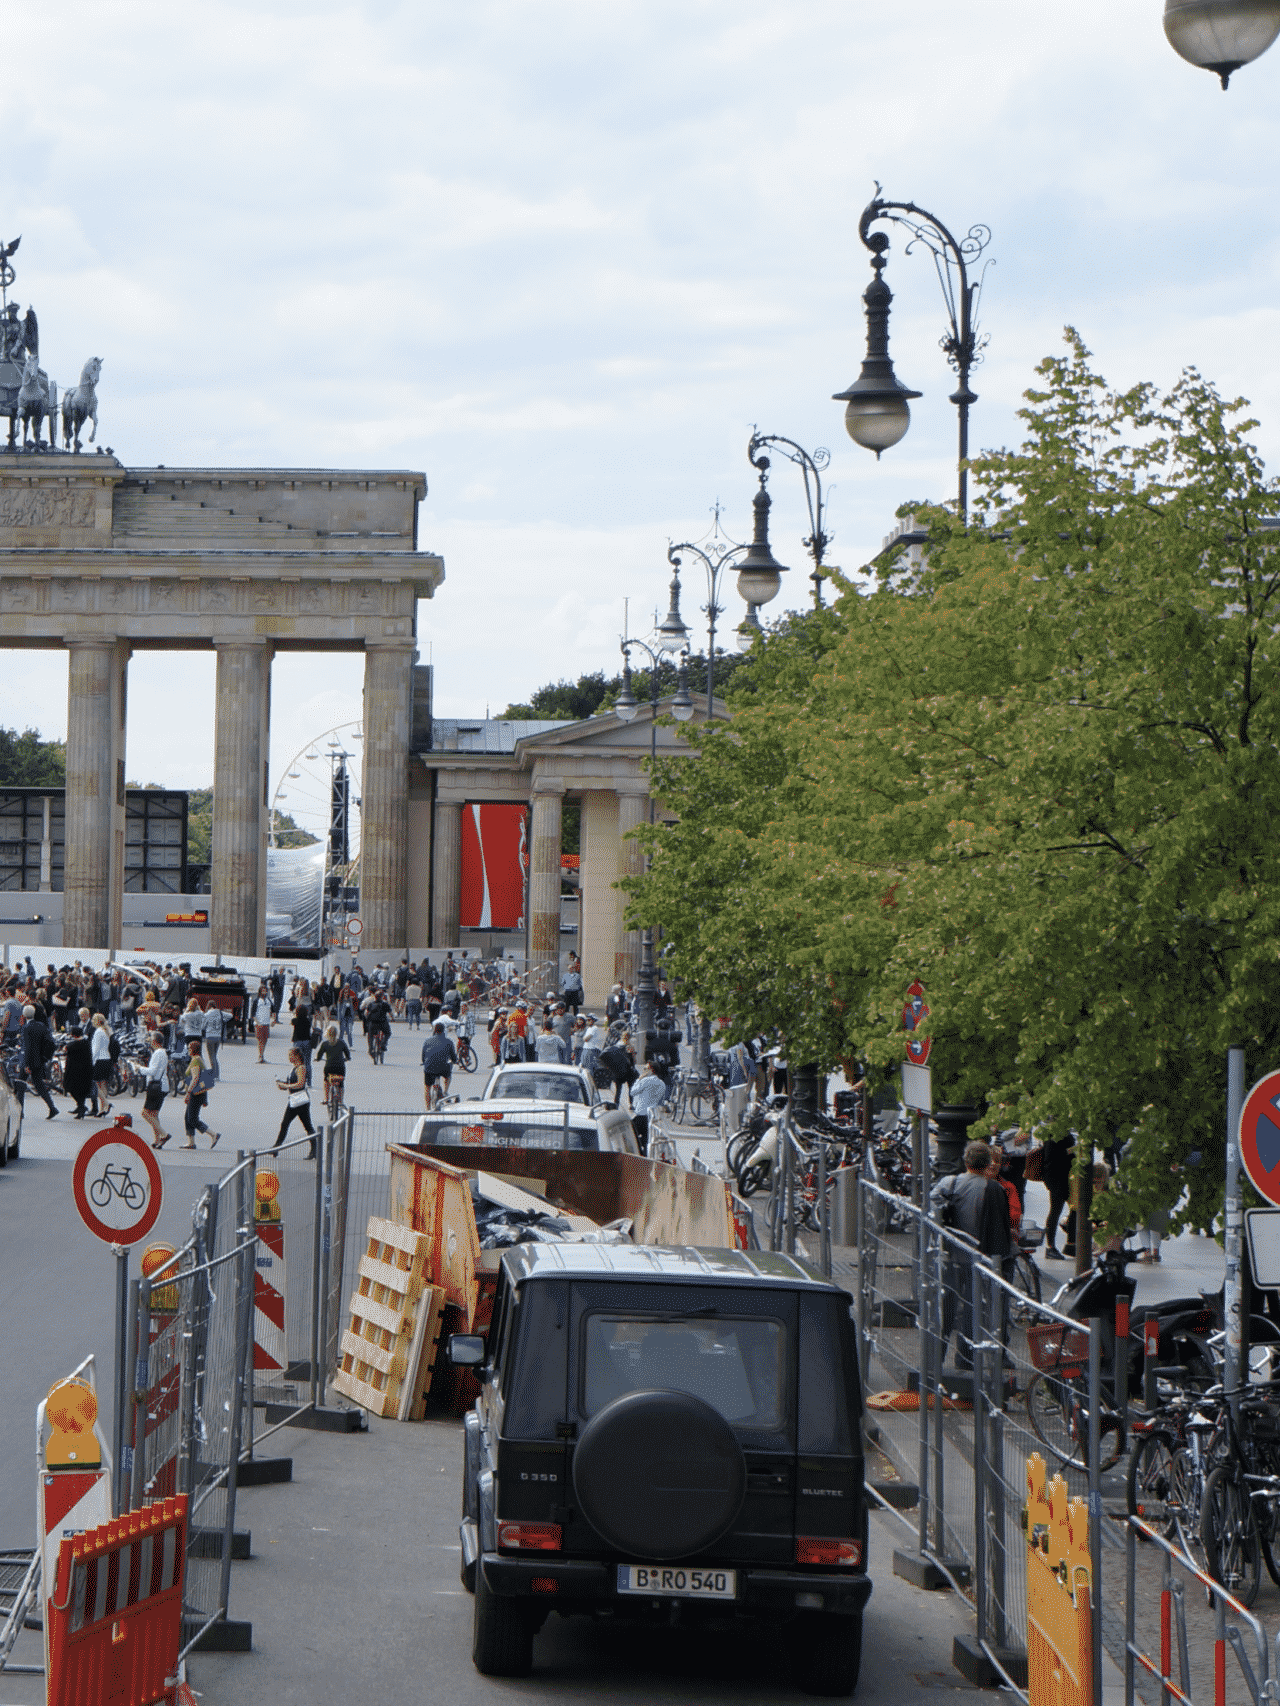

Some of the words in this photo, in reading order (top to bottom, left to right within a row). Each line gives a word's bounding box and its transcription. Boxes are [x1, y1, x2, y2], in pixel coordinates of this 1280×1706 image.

[531, 1473, 558, 1482] 350
[802, 1488, 844, 1497] BLUETEC
[637, 1569, 649, 1587] B
[662, 1570, 687, 1590] RO
[691, 1572, 727, 1591] 540
